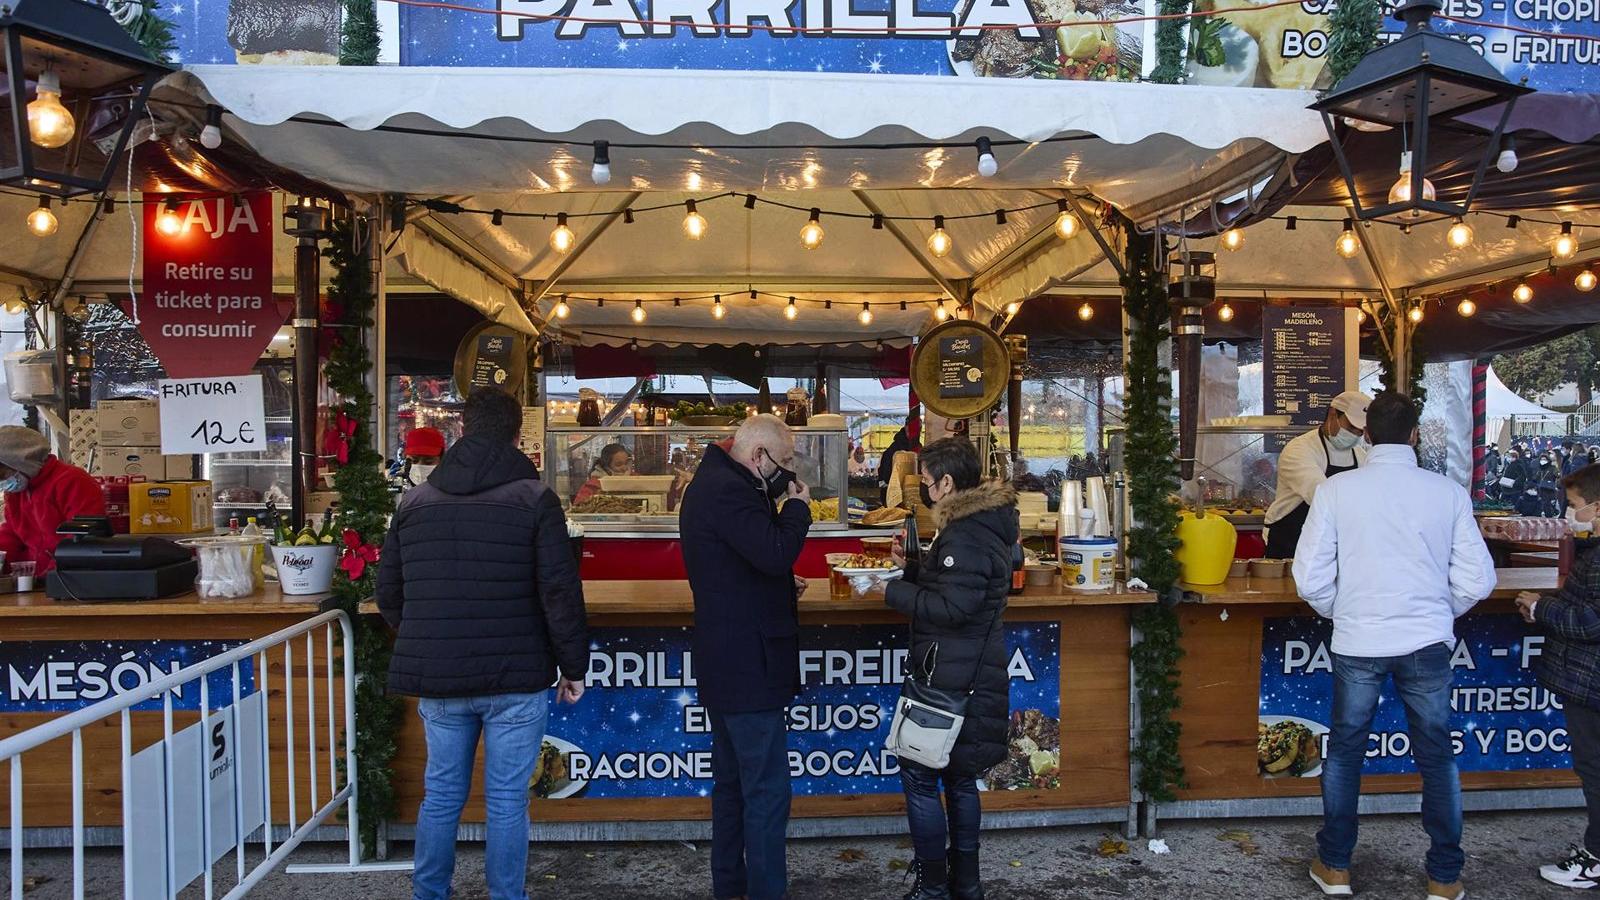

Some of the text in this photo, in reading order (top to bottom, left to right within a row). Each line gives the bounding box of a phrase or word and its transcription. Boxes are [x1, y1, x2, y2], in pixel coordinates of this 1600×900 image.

[165, 262, 253, 280] Retire su
[155, 290, 262, 313] ticket para
[162, 320, 256, 337] consumir
[8, 650, 182, 700] MESÓN
[1474, 729, 1497, 754] Y
[1506, 728, 1572, 754] BOC
[569, 748, 901, 780] RACIONE BOCAD
